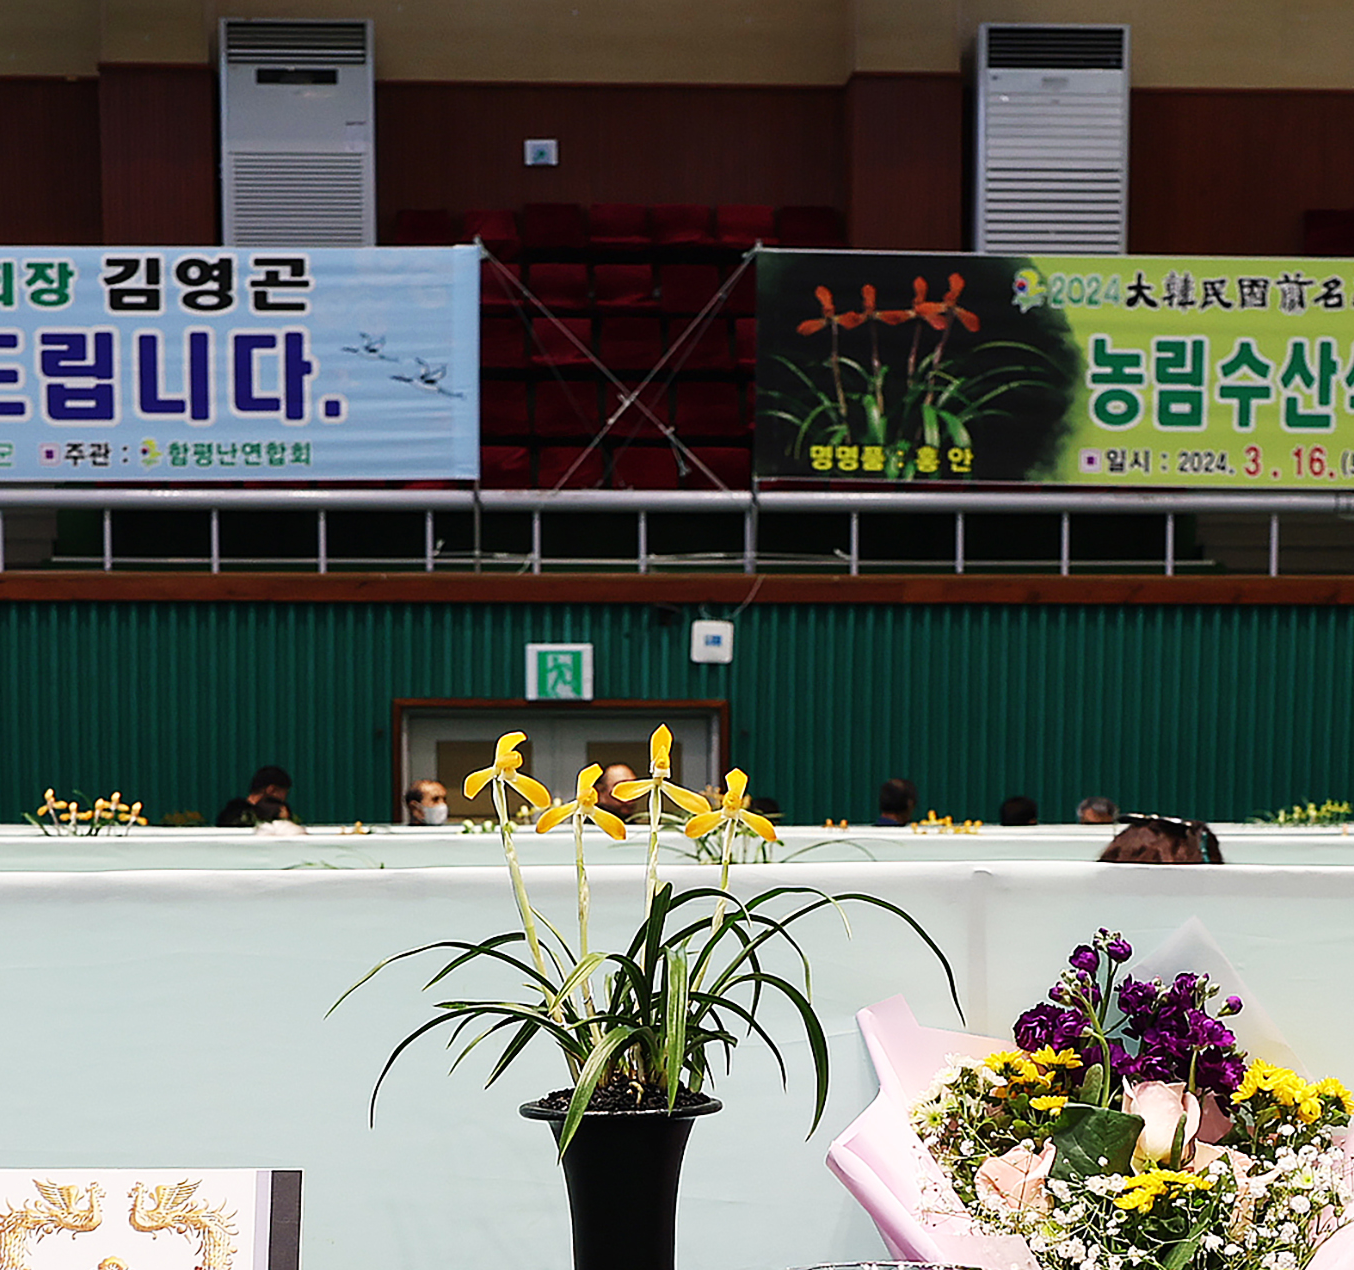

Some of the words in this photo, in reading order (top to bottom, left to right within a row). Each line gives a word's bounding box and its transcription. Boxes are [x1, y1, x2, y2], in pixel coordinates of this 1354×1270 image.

[103, 257, 311, 312] 김영곤
[65, 441, 111, 467] 주관
[168, 442, 312, 467] 함평난연합회
[1106, 449, 1151, 473] 일시
